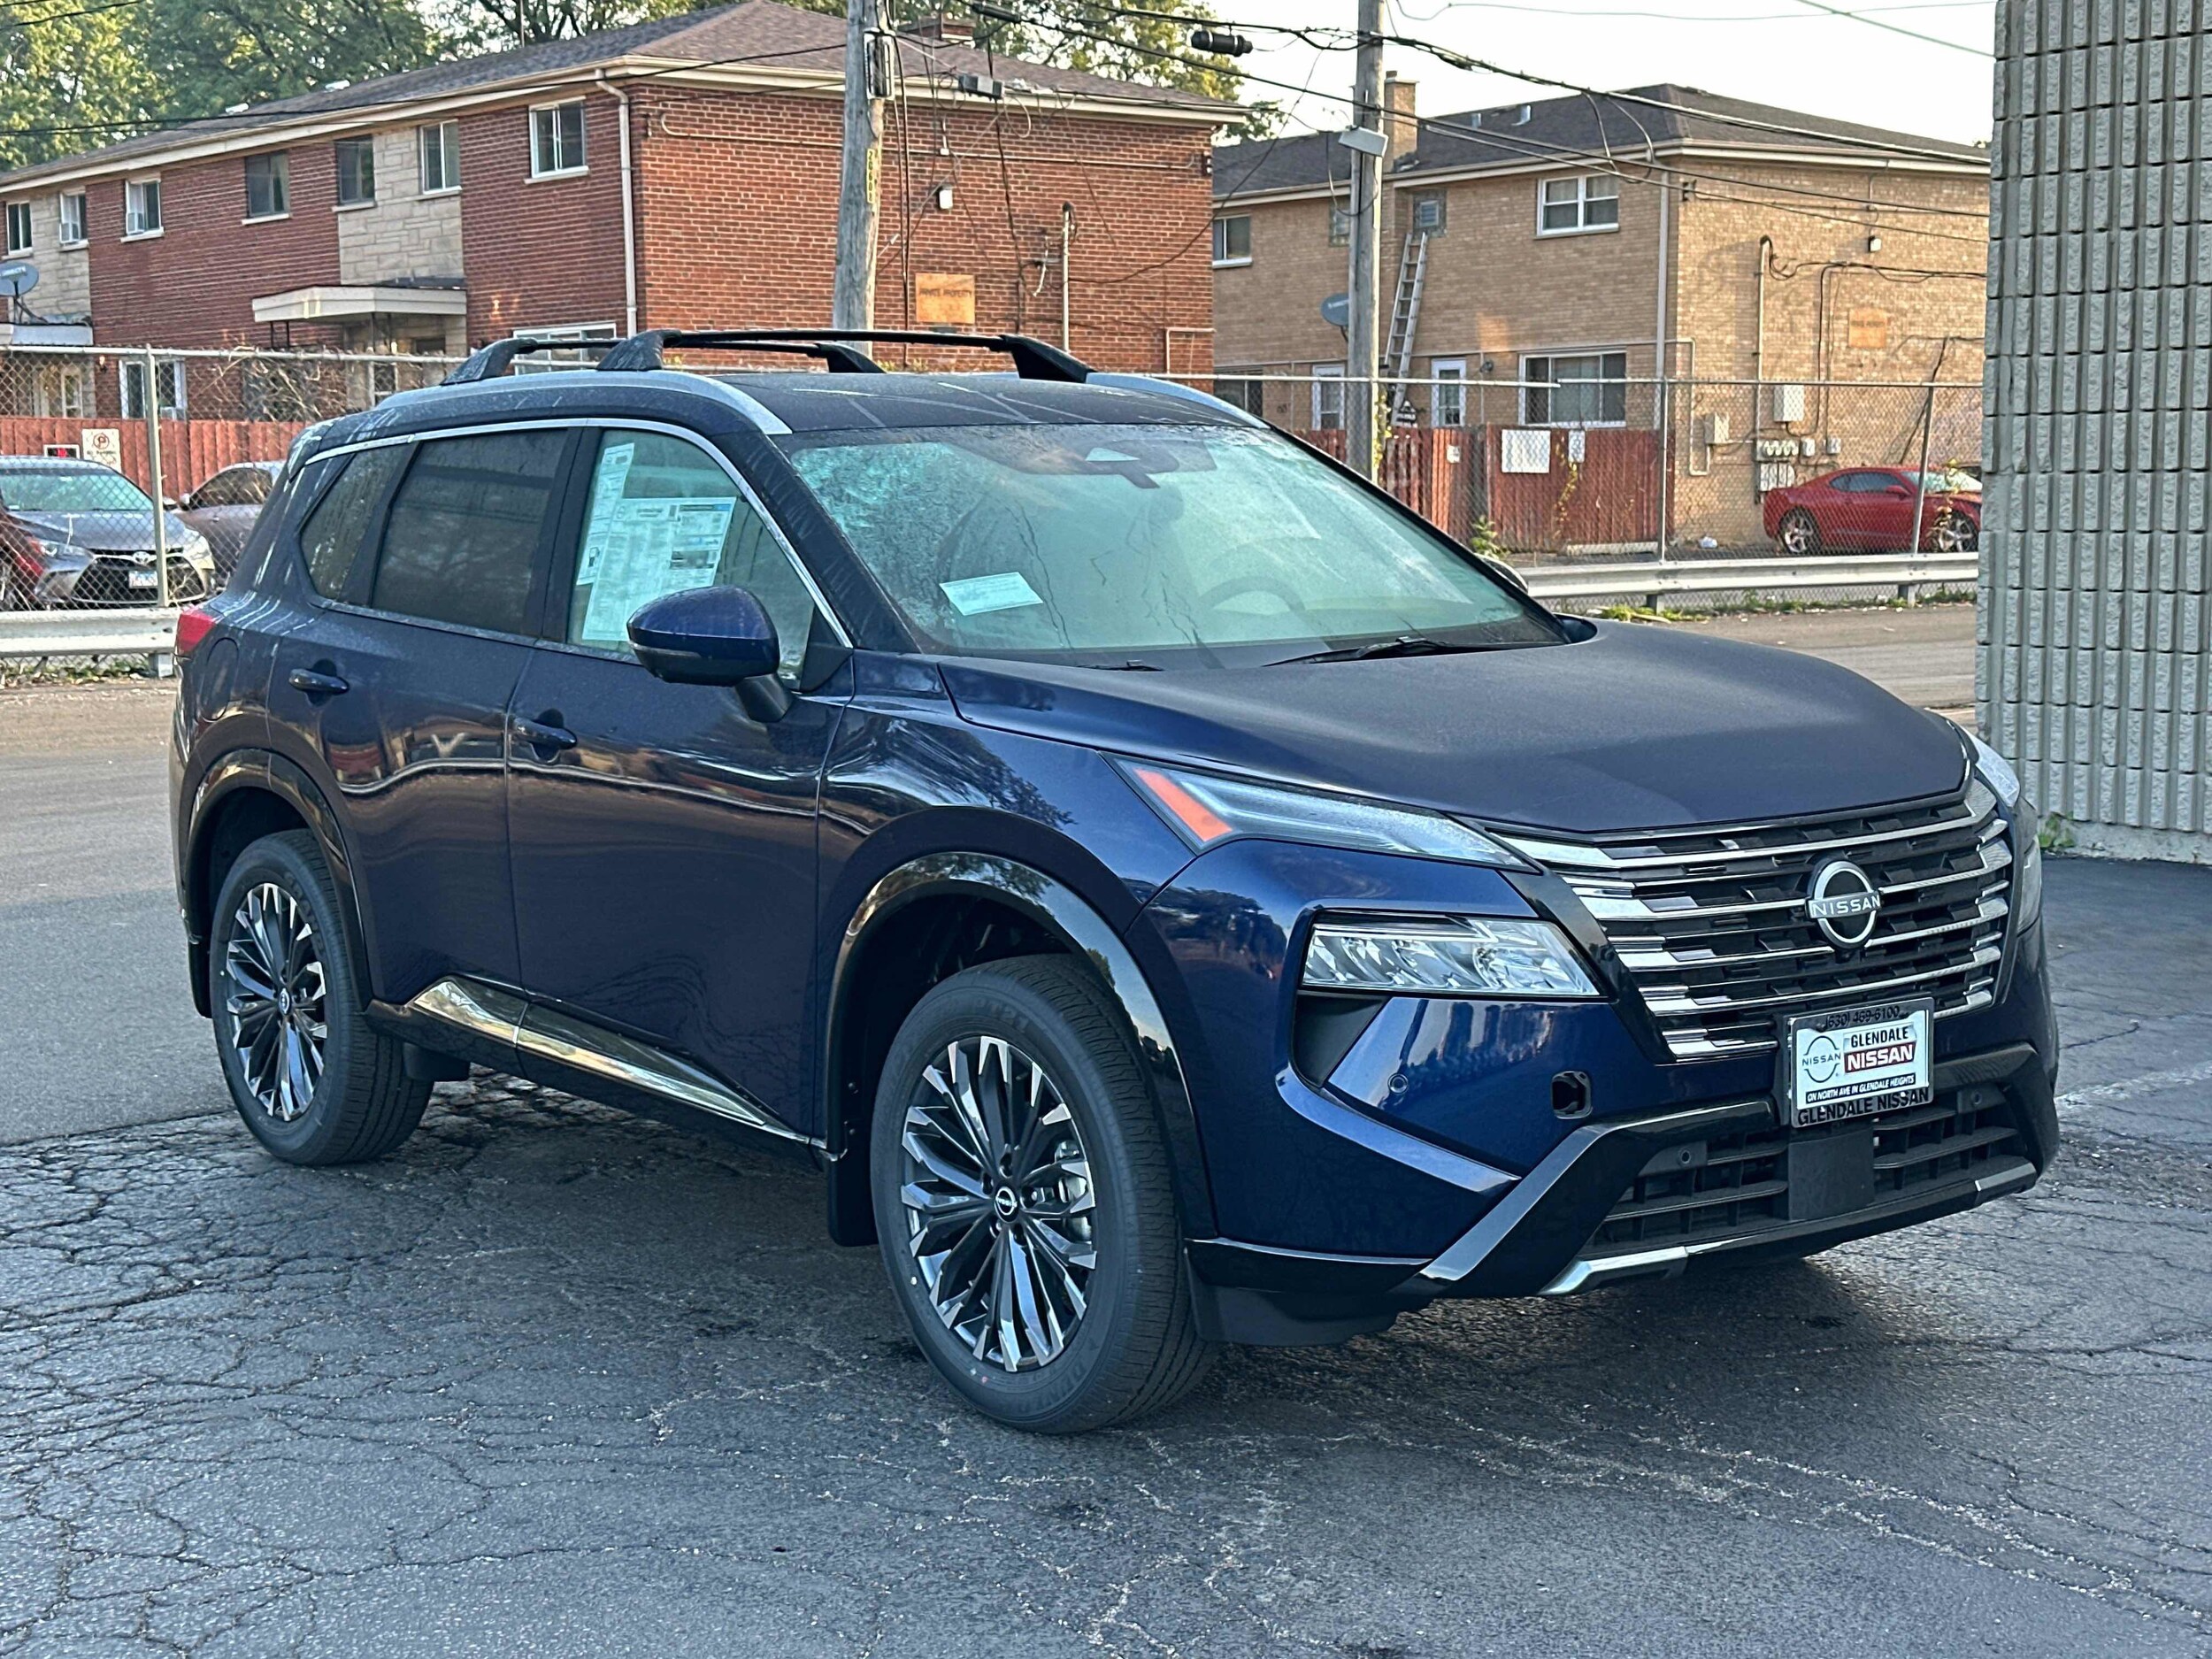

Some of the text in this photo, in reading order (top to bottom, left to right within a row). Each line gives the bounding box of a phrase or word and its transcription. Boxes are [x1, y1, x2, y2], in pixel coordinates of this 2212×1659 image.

[1812, 895, 1881, 917] NISSAN
[1825, 1005, 1900, 1028] (630) 469-6100
[1851, 1027, 1909, 1048] GLENDALE
[1802, 1052, 1841, 1067] NISSAN
[1847, 1044, 1913, 1071] NISSAN
[1807, 1074, 1915, 1102] ON NORTH AVE IN GLENDALE HEIGHTS
[1798, 1087, 1929, 1126] GLENDALE NISSAN
